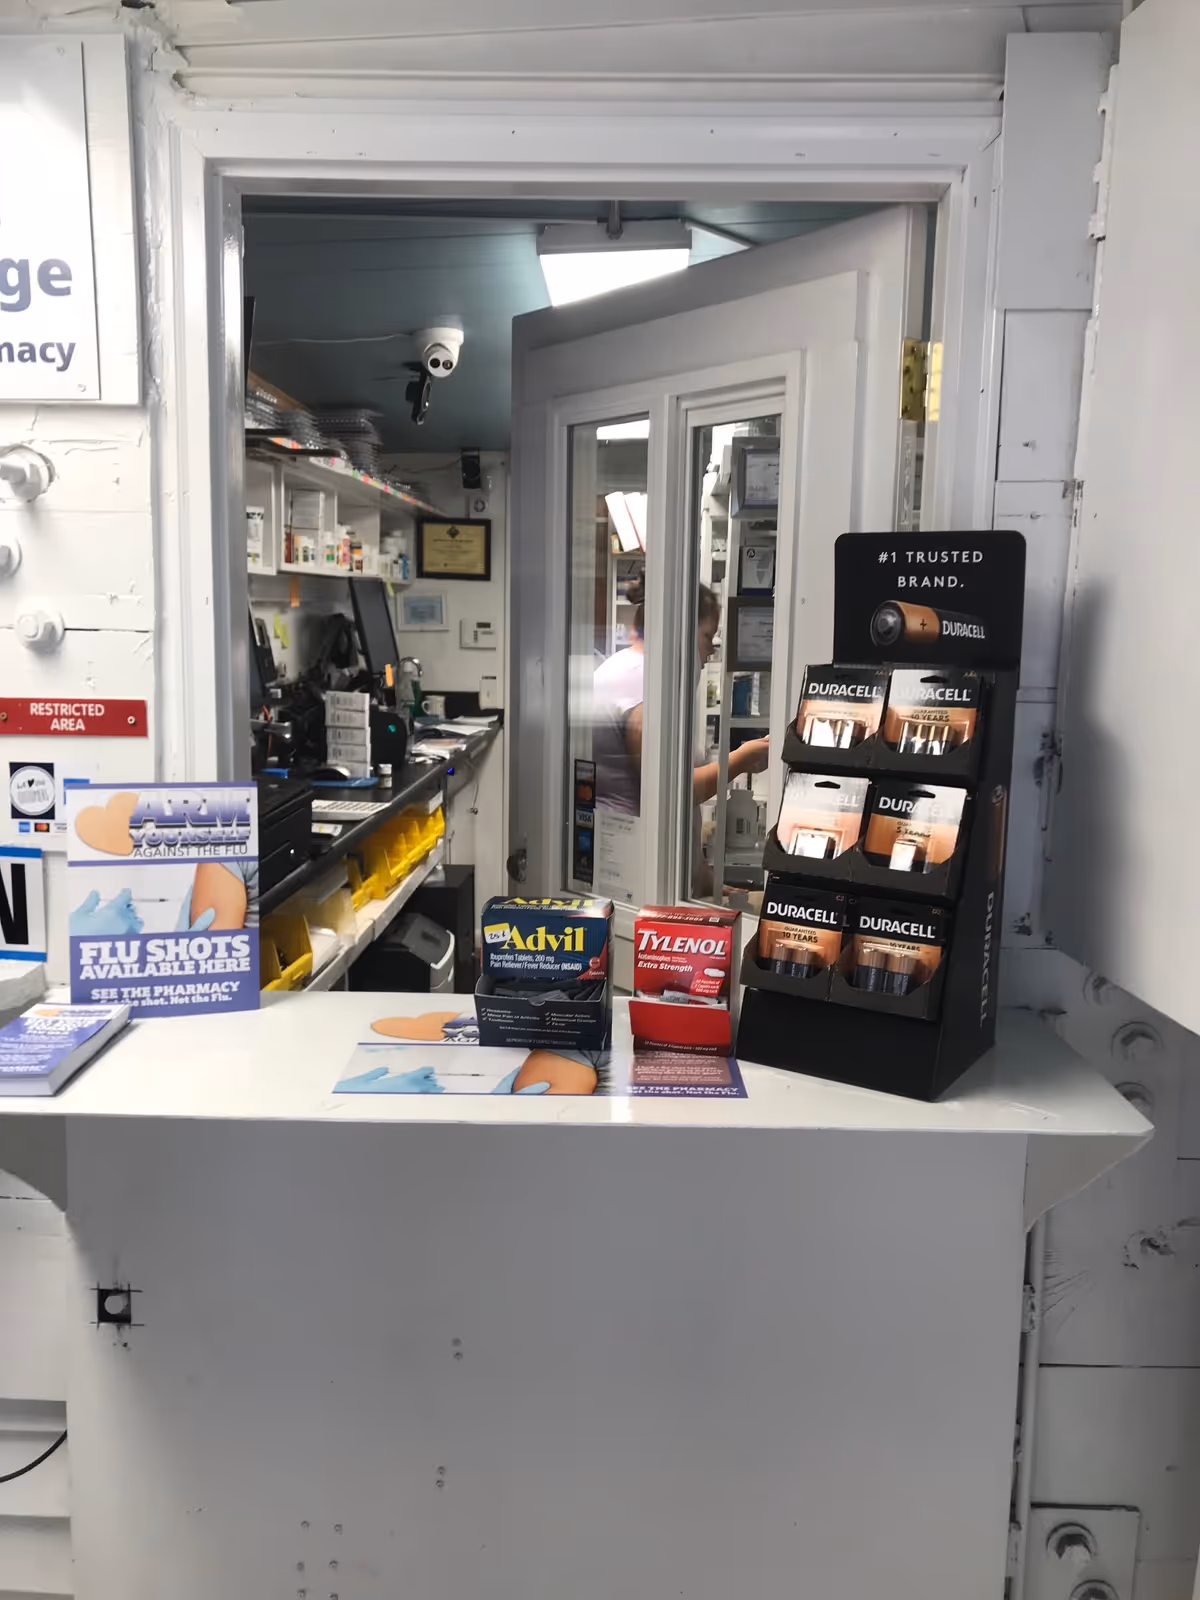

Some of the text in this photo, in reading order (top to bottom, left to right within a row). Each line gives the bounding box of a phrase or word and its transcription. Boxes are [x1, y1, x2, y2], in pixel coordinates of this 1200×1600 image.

[877, 551, 983, 563] #1 TRUSTED
[897, 576, 965, 588] BRAND.
[942, 620, 985, 639] DURACELL
[808, 682, 880, 698] DURACELL
[30, 703, 105, 716] RESTRICTED
[50, 718, 85, 731] AREA
[922, 714, 950, 722] YEARS
[578, 814, 591, 822] VISA
[133, 845, 248, 858] AGAINST THE FLU
[767, 902, 837, 924] DURACELL
[859, 916, 935, 939] DURACELL
[500, 925, 585, 952] Advil
[637, 929, 726, 955] TYLENOL
[792, 933, 818, 943] YEARS
[79, 935, 250, 965] FLU SHOTS
[546, 955, 555, 963] mg
[979, 892, 994, 1028] DURACELL
[79, 957, 251, 980] AVAILABLE HERE
[540, 962, 560, 970] Reducer
[637, 961, 693, 973] Extra Strength
[91, 981, 240, 1001] SEE THE PHARMACY
[141, 997, 168, 1006] shot.
[170, 995, 190, 1004] Not
[191, 994, 209, 1003] the
[210, 992, 232, 1001] Flu.
